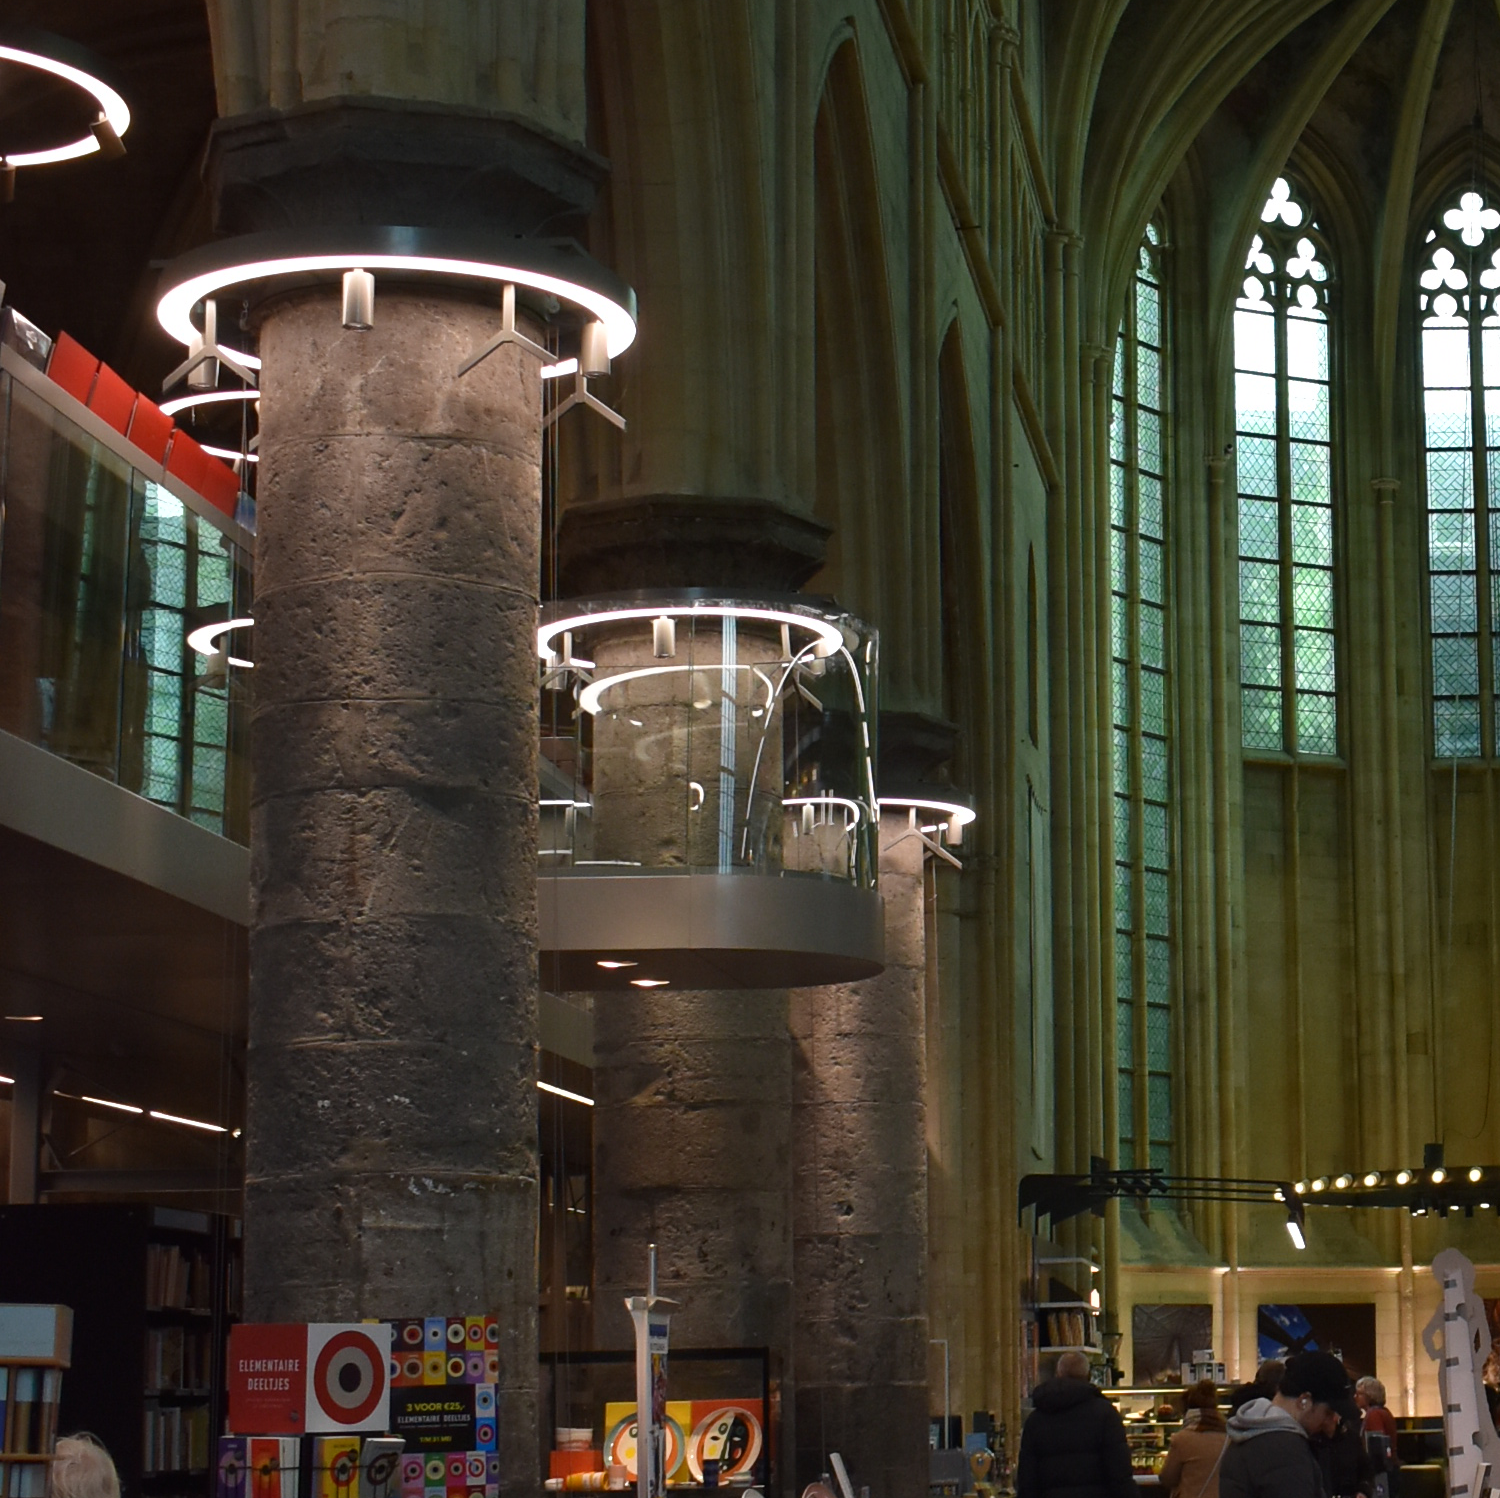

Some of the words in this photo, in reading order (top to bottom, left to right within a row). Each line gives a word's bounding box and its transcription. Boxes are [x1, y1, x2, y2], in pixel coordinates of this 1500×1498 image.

[239, 1359, 300, 1373] ELEMENTAIRE
[247, 1378, 290, 1391] DEELTJES
[415, 1402, 442, 1412] VOOR
